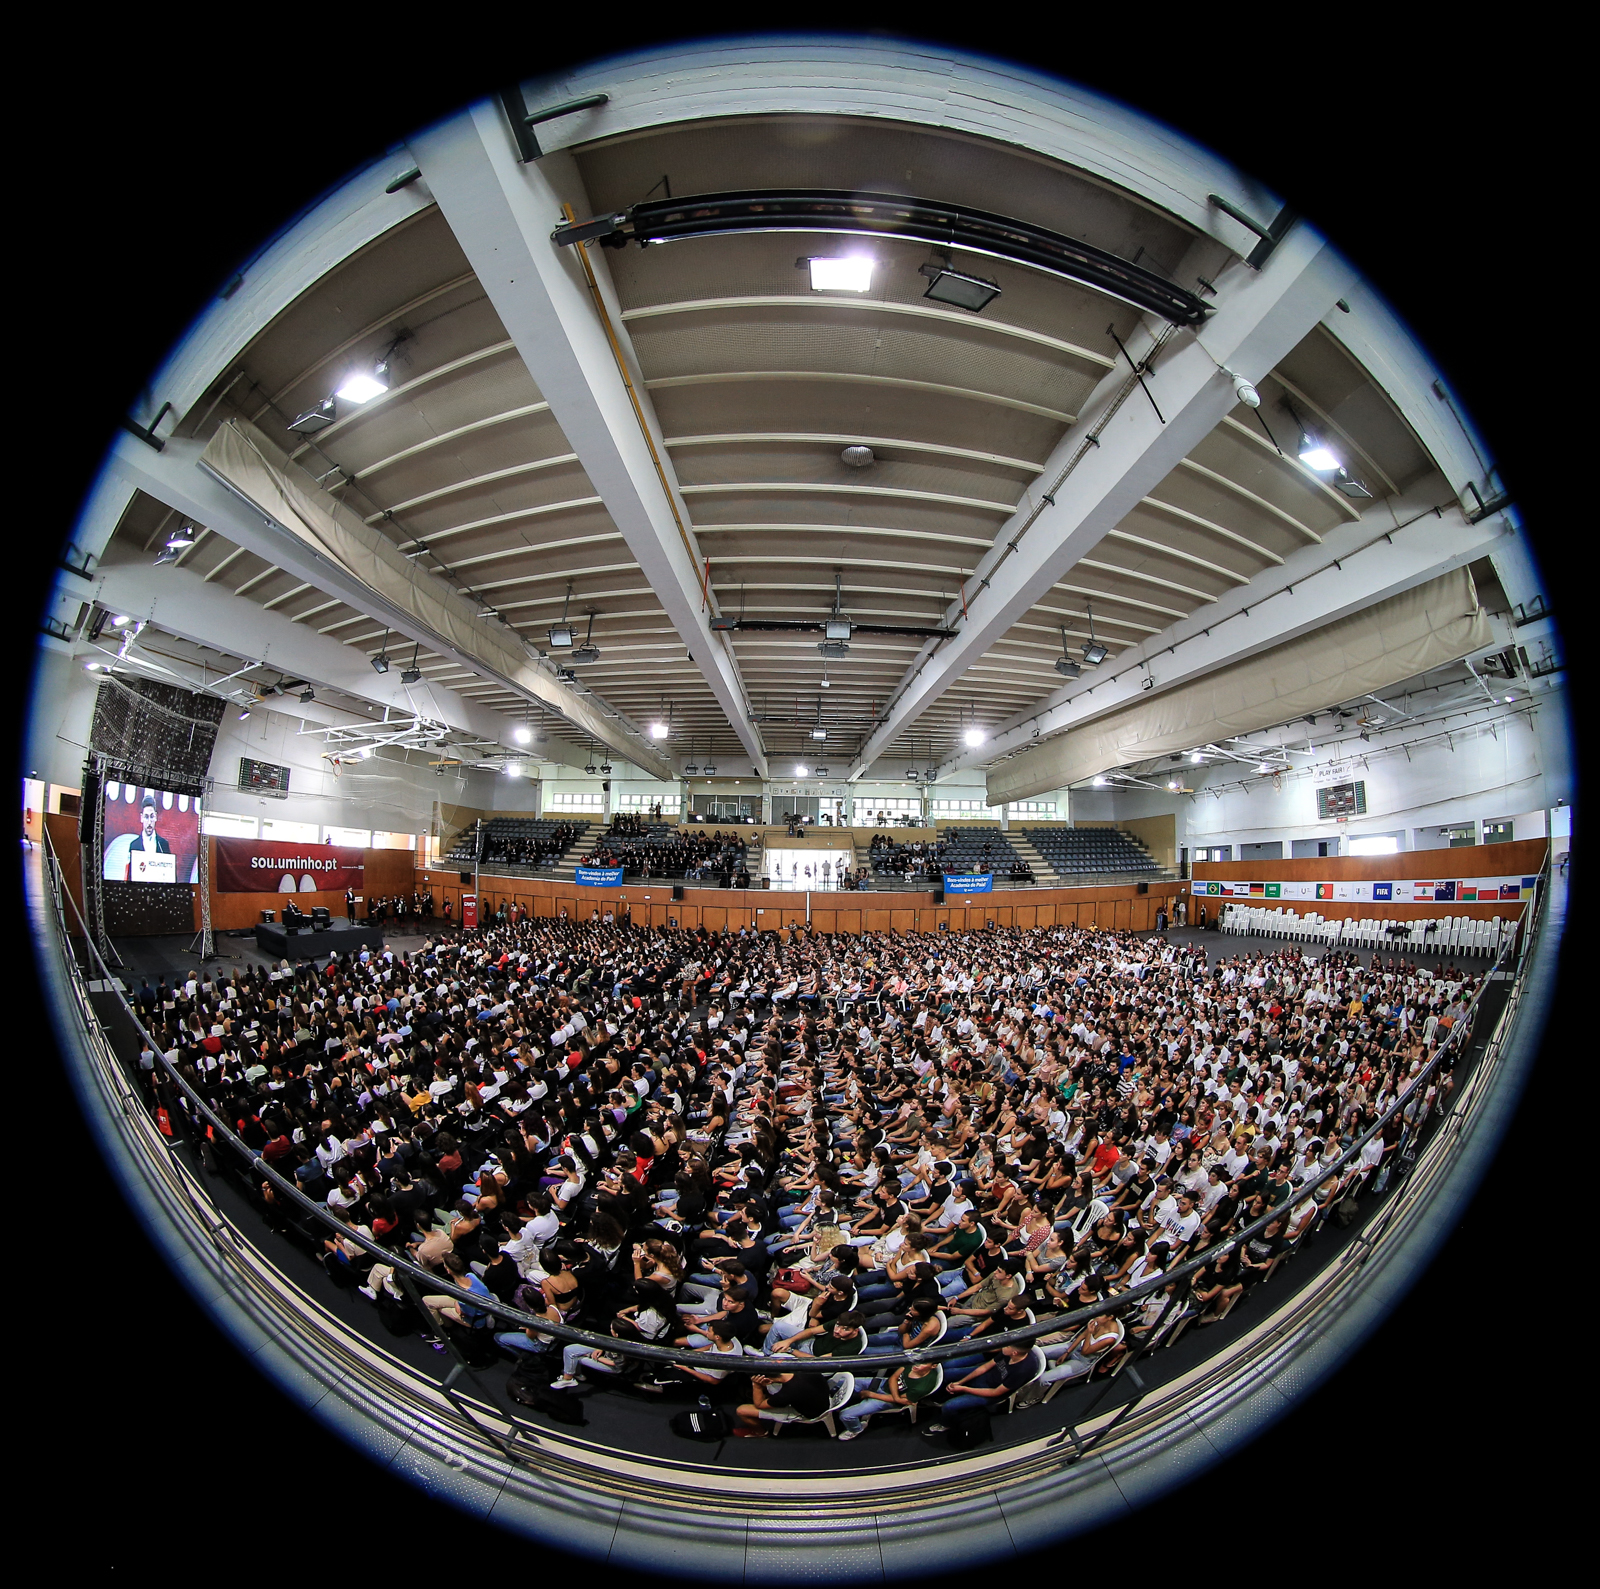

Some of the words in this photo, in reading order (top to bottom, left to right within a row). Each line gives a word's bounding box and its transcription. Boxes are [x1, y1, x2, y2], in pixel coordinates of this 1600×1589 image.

[251, 856, 337, 872] sou.uminho.pt
[1376, 888, 1389, 896] FIFA
[1165, 1217, 1185, 1237] WAVE
